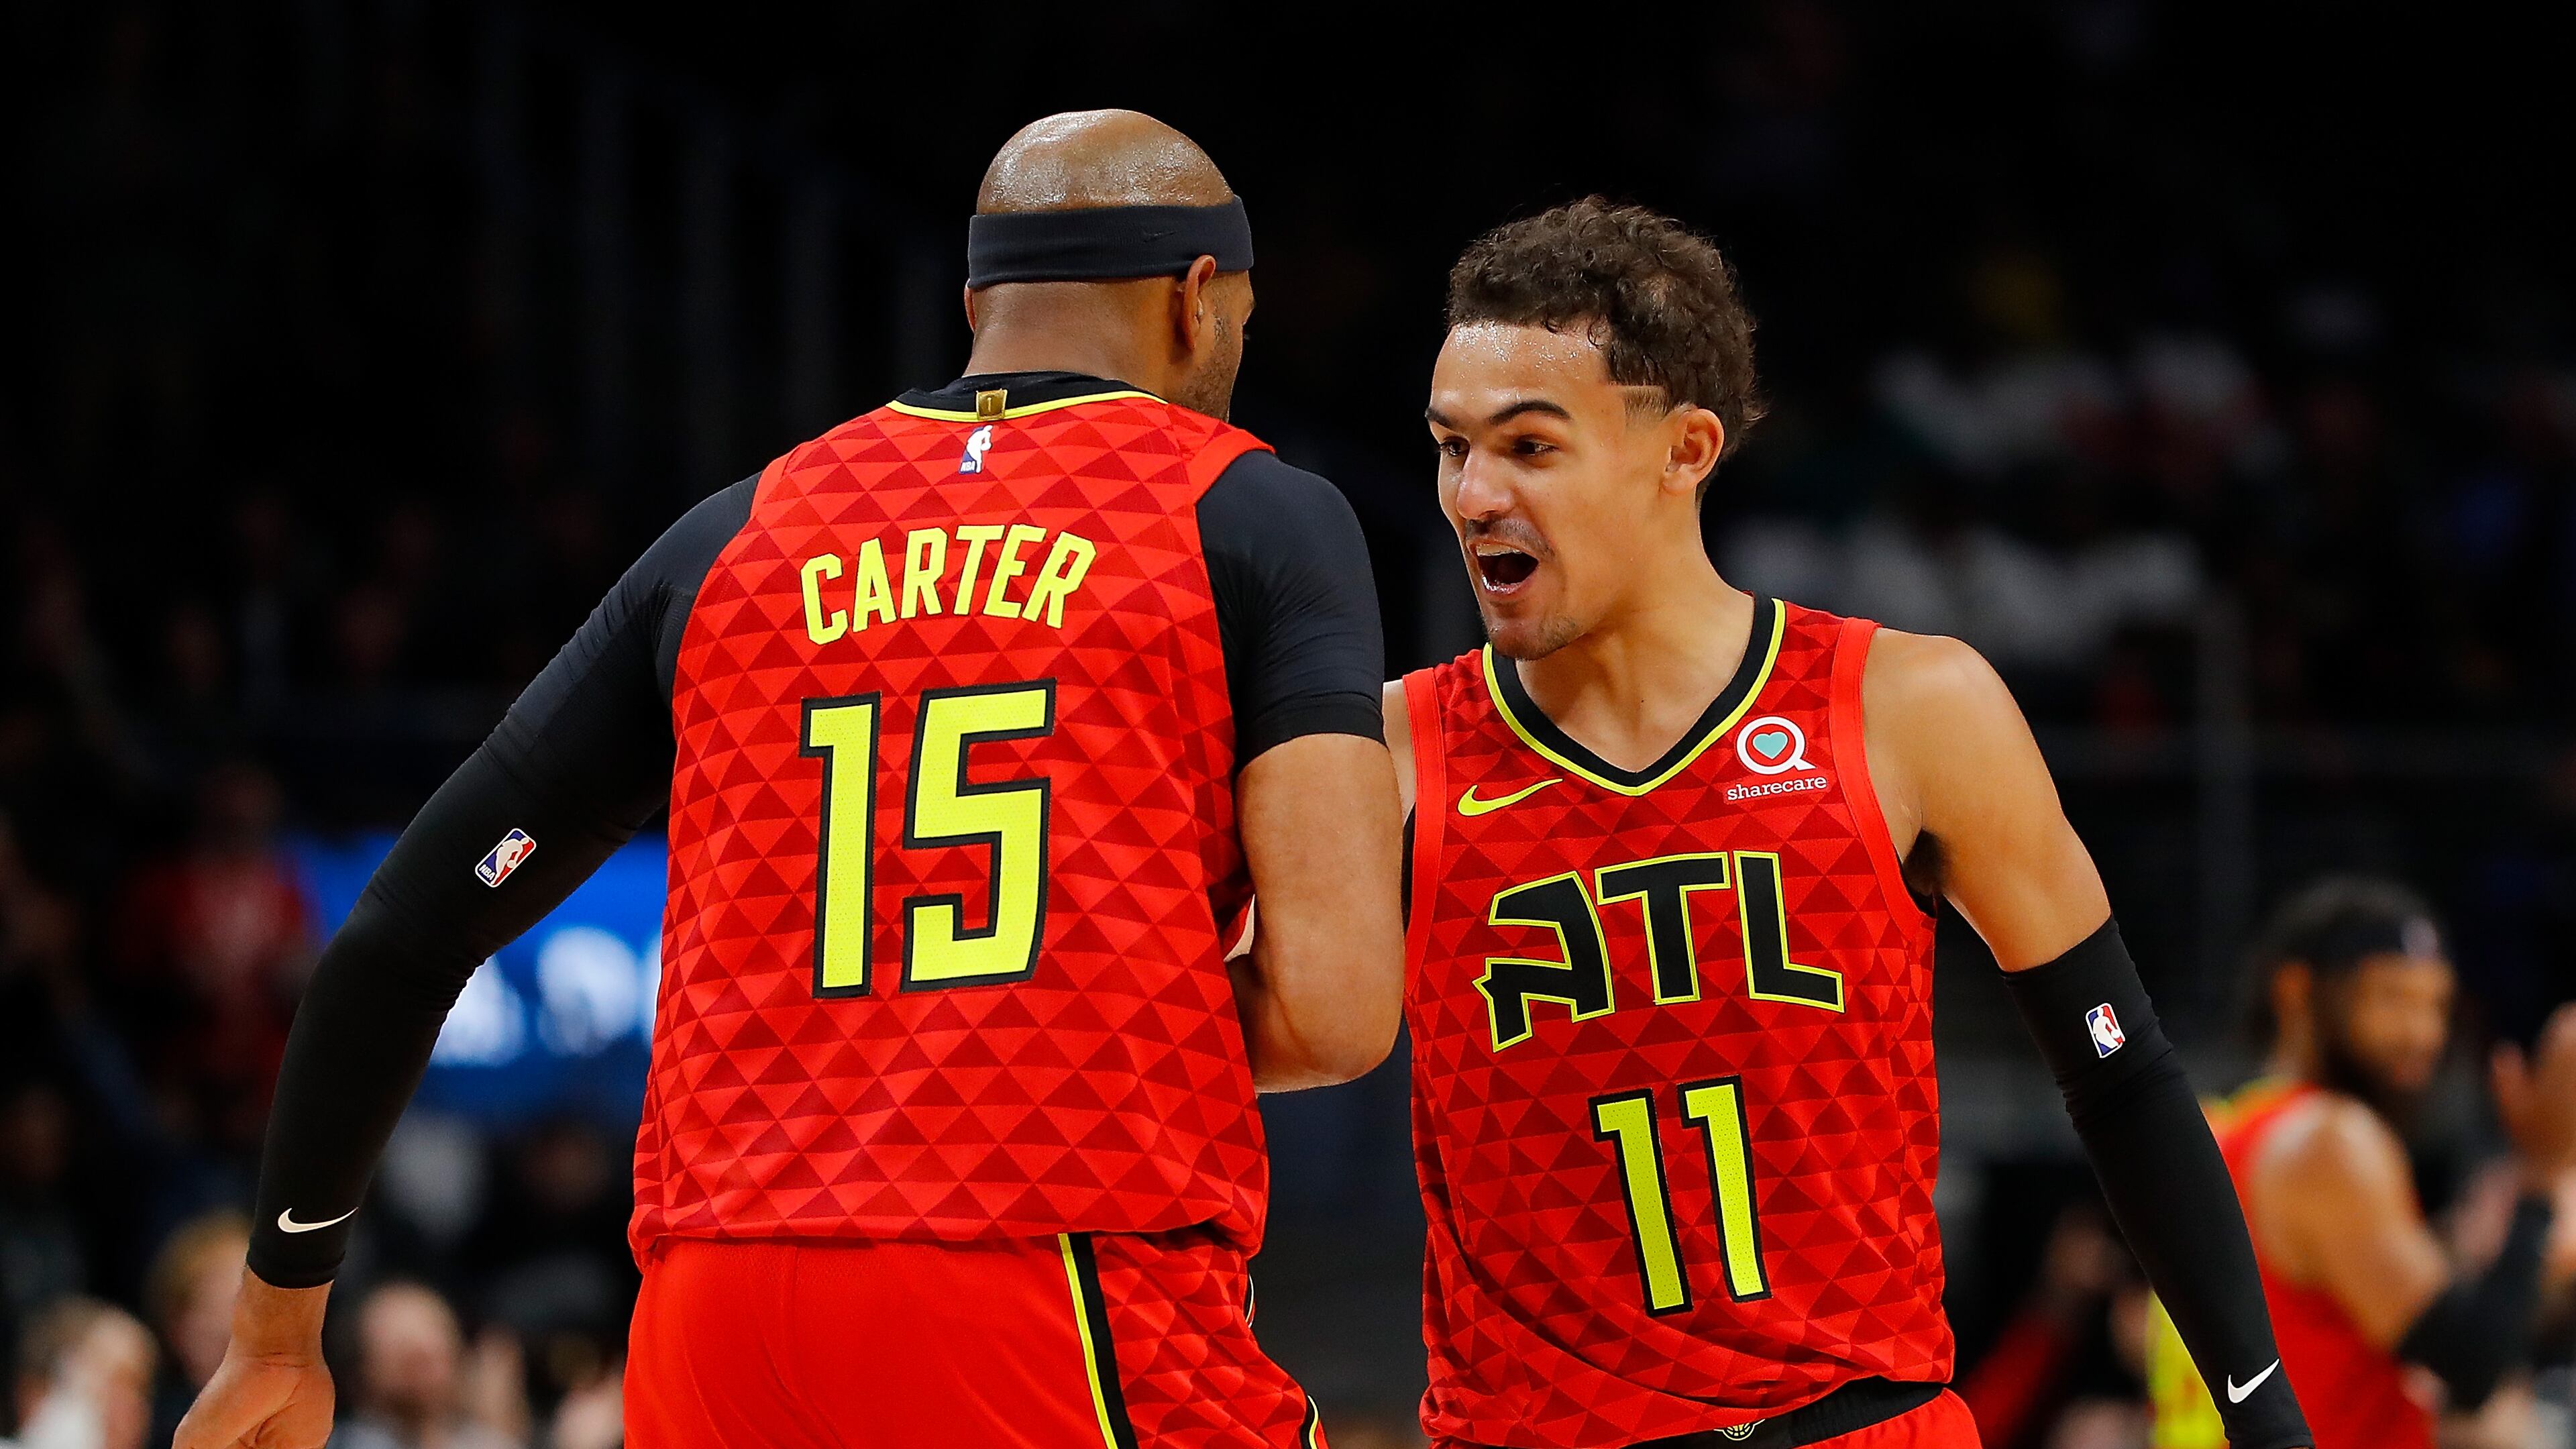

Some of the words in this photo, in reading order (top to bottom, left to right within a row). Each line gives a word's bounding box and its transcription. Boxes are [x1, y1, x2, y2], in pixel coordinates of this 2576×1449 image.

[961, 462, 975, 471] NBA
[800, 524, 1097, 645] CARTER
[799, 678, 1057, 998] 15
[1727, 776, 1827, 800] sharecare
[480, 865, 495, 880] NBA
[1472, 850, 1845, 1053] ATL
[1587, 1075, 1773, 1318] 11
